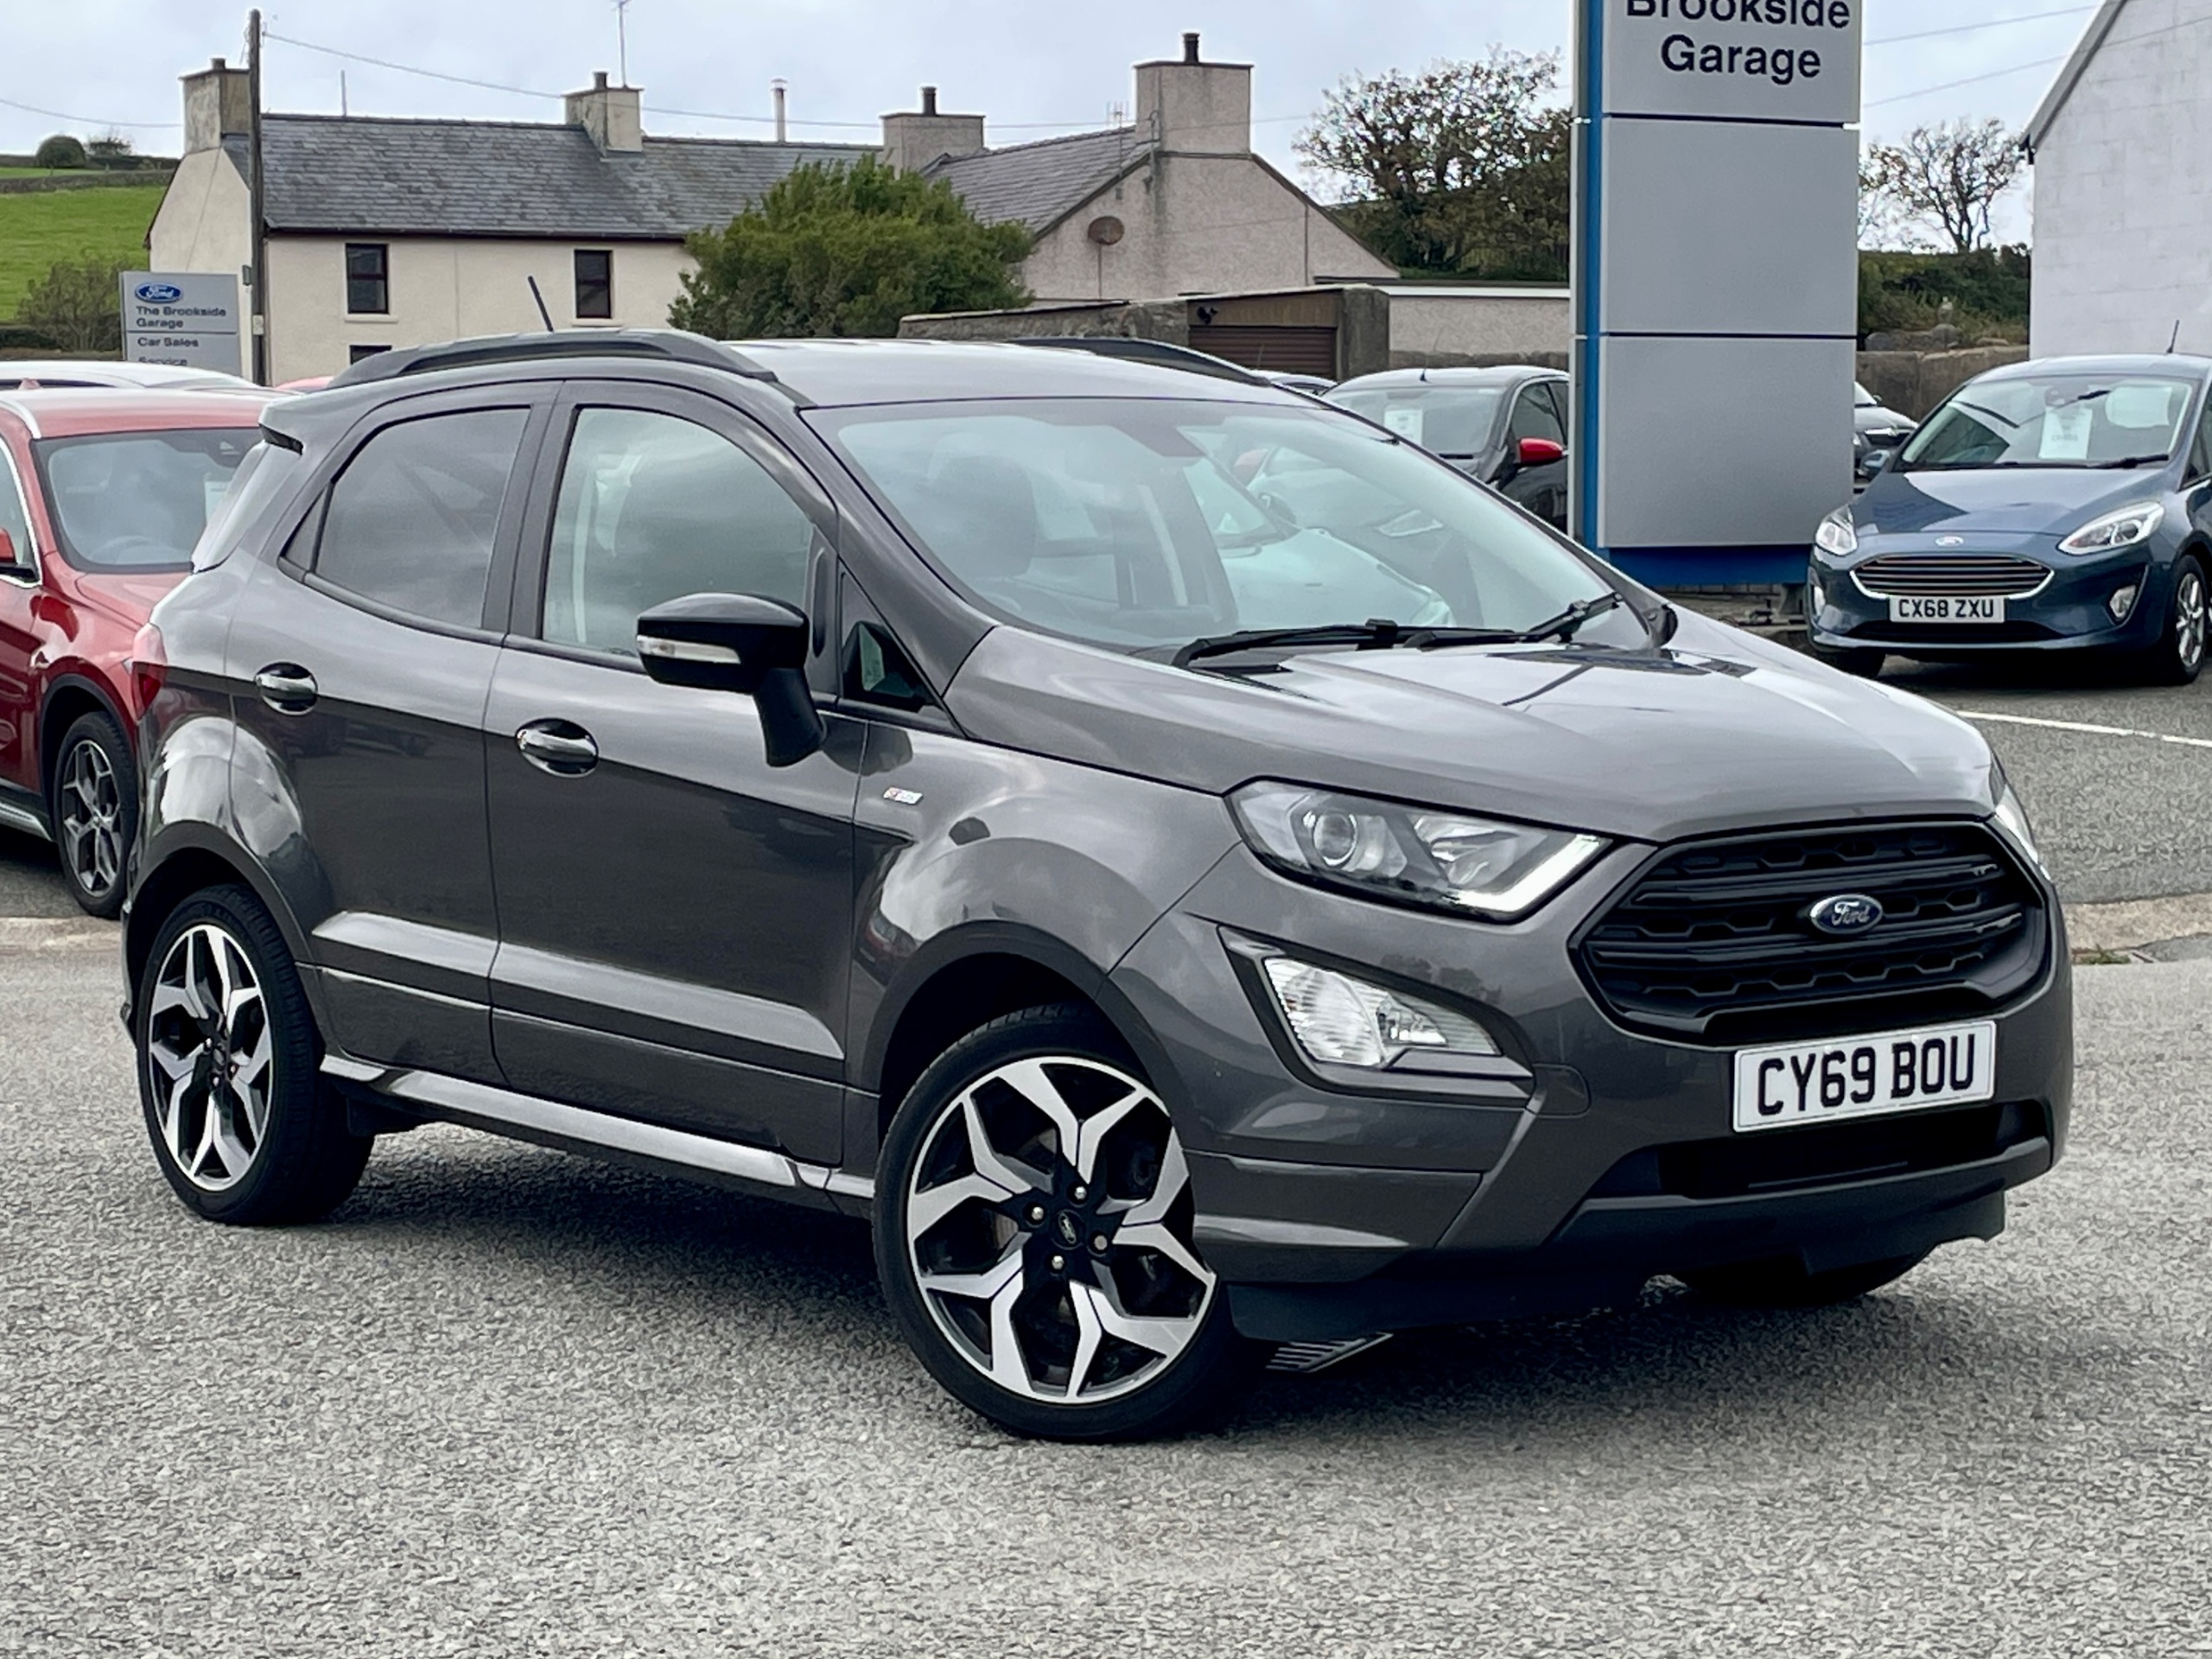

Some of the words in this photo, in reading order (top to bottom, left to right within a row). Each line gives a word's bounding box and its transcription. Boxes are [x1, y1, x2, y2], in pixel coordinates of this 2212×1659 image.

[1661, 34, 1821, 86] Garage
[136, 306, 160, 315] The
[162, 306, 226, 316] Brookside
[136, 317, 184, 329] Garage
[137, 337, 161, 346] Car
[163, 337, 199, 347] Sales
[1898, 599, 1949, 618] CX68
[1955, 599, 1994, 618] ZXU
[1831, 900, 1871, 926] Ford
[1758, 1046, 1876, 1116] CY69
[1890, 1033, 1975, 1099] BOU
